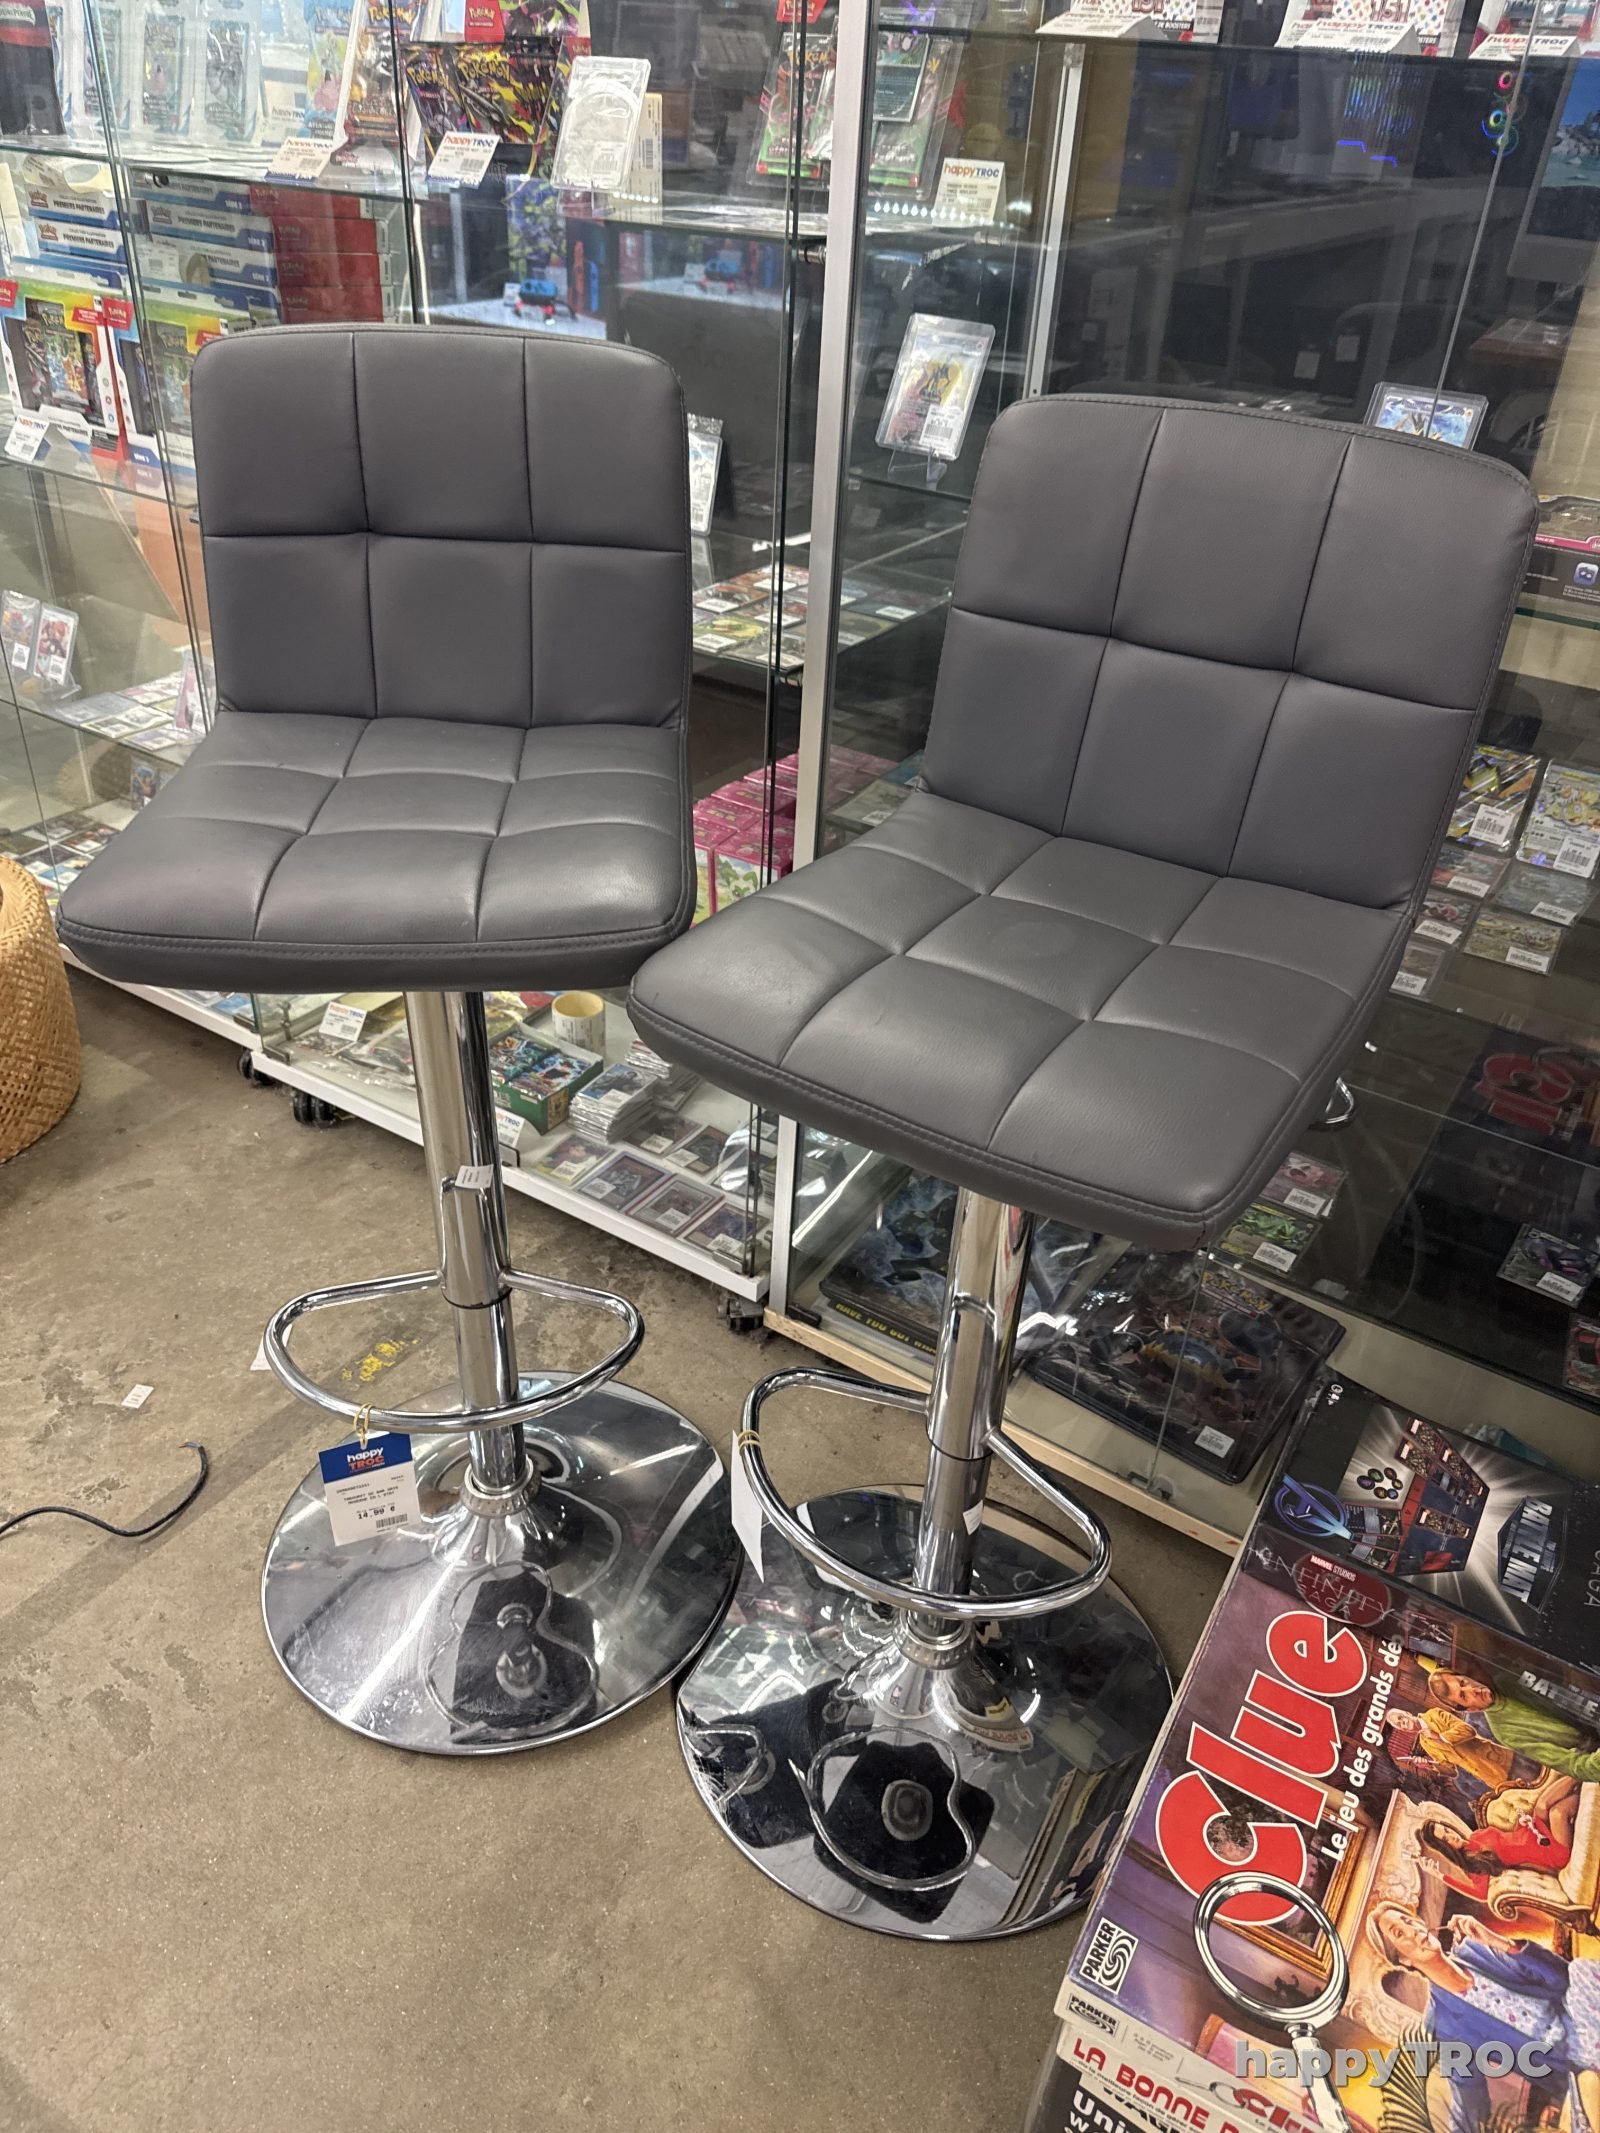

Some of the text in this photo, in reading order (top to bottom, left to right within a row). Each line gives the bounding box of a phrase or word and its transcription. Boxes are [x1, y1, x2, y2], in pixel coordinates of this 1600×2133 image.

[347, 1447, 384, 1462] happy
[349, 1456, 385, 1472] TROC
[358, 1507, 385, 1520] 14.99
[1310, 1555, 1357, 1583] MARVEL STUDIOS
[1361, 1667, 1394, 1748] grands
[1155, 1610, 1368, 1927] Clue
[1342, 1745, 1373, 1790] des
[1328, 1789, 1360, 1835] jeu
[1322, 1831, 1347, 1862] Le
[1081, 1921, 1116, 1981] PARKER
[1071, 1996, 1118, 2027] PARKER
[1073, 2037, 1107, 2072] LA
[1116, 2063, 1211, 2130] BONNE
[1073, 2089, 1131, 2133] Uni
